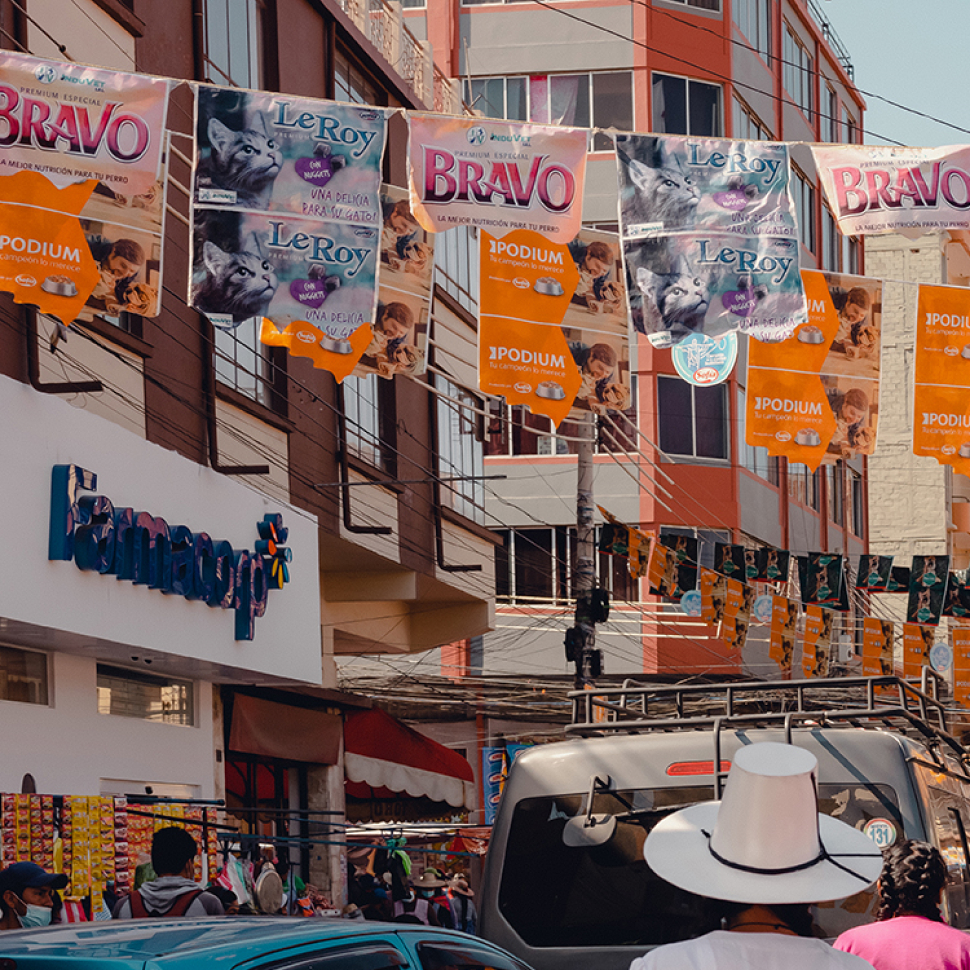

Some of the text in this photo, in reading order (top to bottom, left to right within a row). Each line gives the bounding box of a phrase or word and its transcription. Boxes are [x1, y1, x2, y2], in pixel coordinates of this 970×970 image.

[20, 87, 101, 106] PREMIUM ESPECIAL
[273, 101, 377, 157] LeRoy
[454, 151, 490, 159] PREMIUM
[688, 142, 781, 184] LeRoy
[8, 160, 32, 169] MEJOR
[34, 164, 72, 175] NUTRICIÓN
[106, 175, 128, 183] PERRO
[421, 144, 575, 213] BRAVO
[311, 189, 370, 206] UNA DELICIA
[303, 202, 327, 215] PARA
[331, 207, 340, 218] SU
[472, 218, 507, 227] NUTRICIÓN
[510, 221, 526, 229] PARA
[539, 225, 560, 233] PERRO
[0, 235, 80, 262] PODIUM
[268, 221, 371, 276] LeRoy
[497, 242, 564, 265] PODIUM
[499, 257, 530, 268] campeón
[539, 265, 564, 273] merece
[696, 240, 793, 283] LeRoy
[306, 310, 364, 323] UNA DELICIA
[497, 348, 565, 368] PODIUM
[499, 363, 531, 373] campeón
[540, 368, 565, 378] merece
[763, 398, 822, 415] PODIUM
[48, 464, 268, 640] Farmacorp
[870, 829, 888, 843] 131
